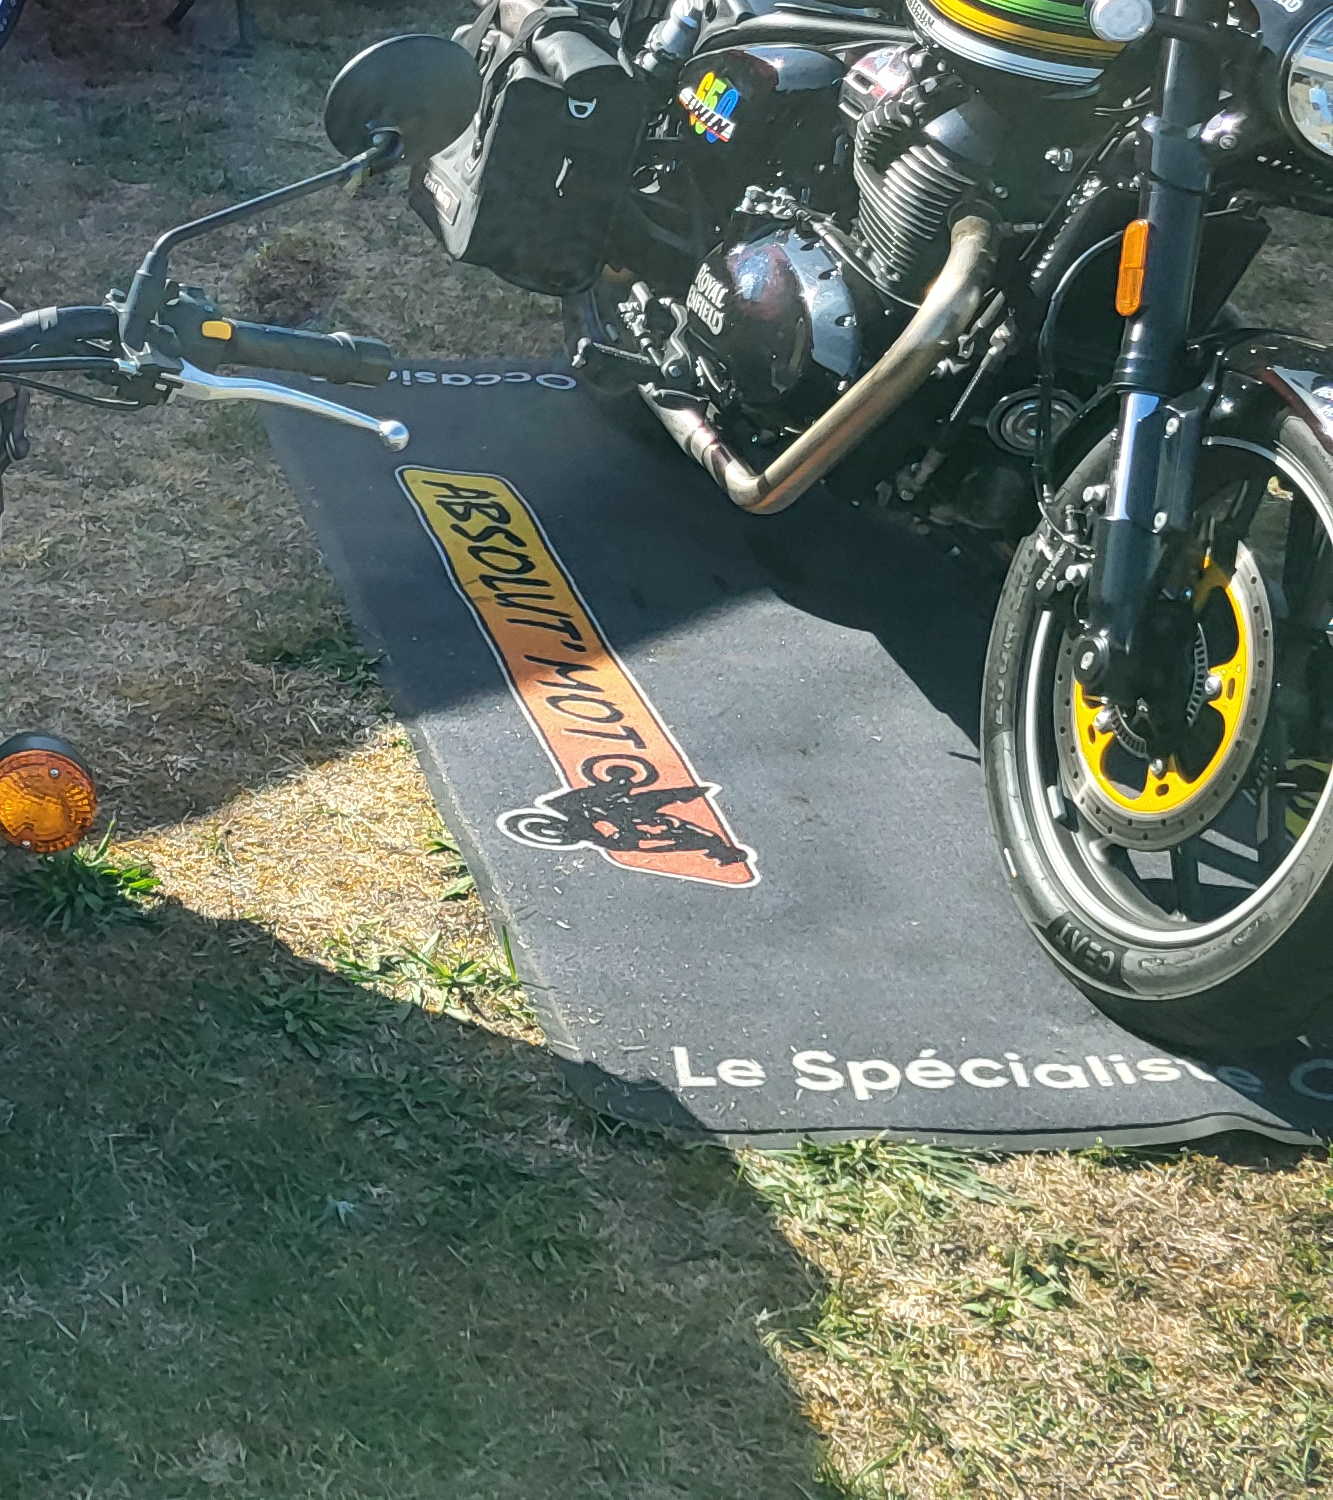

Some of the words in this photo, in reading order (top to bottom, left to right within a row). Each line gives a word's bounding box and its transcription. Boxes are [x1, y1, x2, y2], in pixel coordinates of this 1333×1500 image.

[687, 93, 732, 134] TWIN
[686, 283, 726, 336] ENFIELD
[694, 262, 730, 309] ROYAL
[1055, 920, 1116, 974] CEAT
[672, 1045, 767, 1089] Le
[792, 1048, 1262, 1101] Spécialiste
